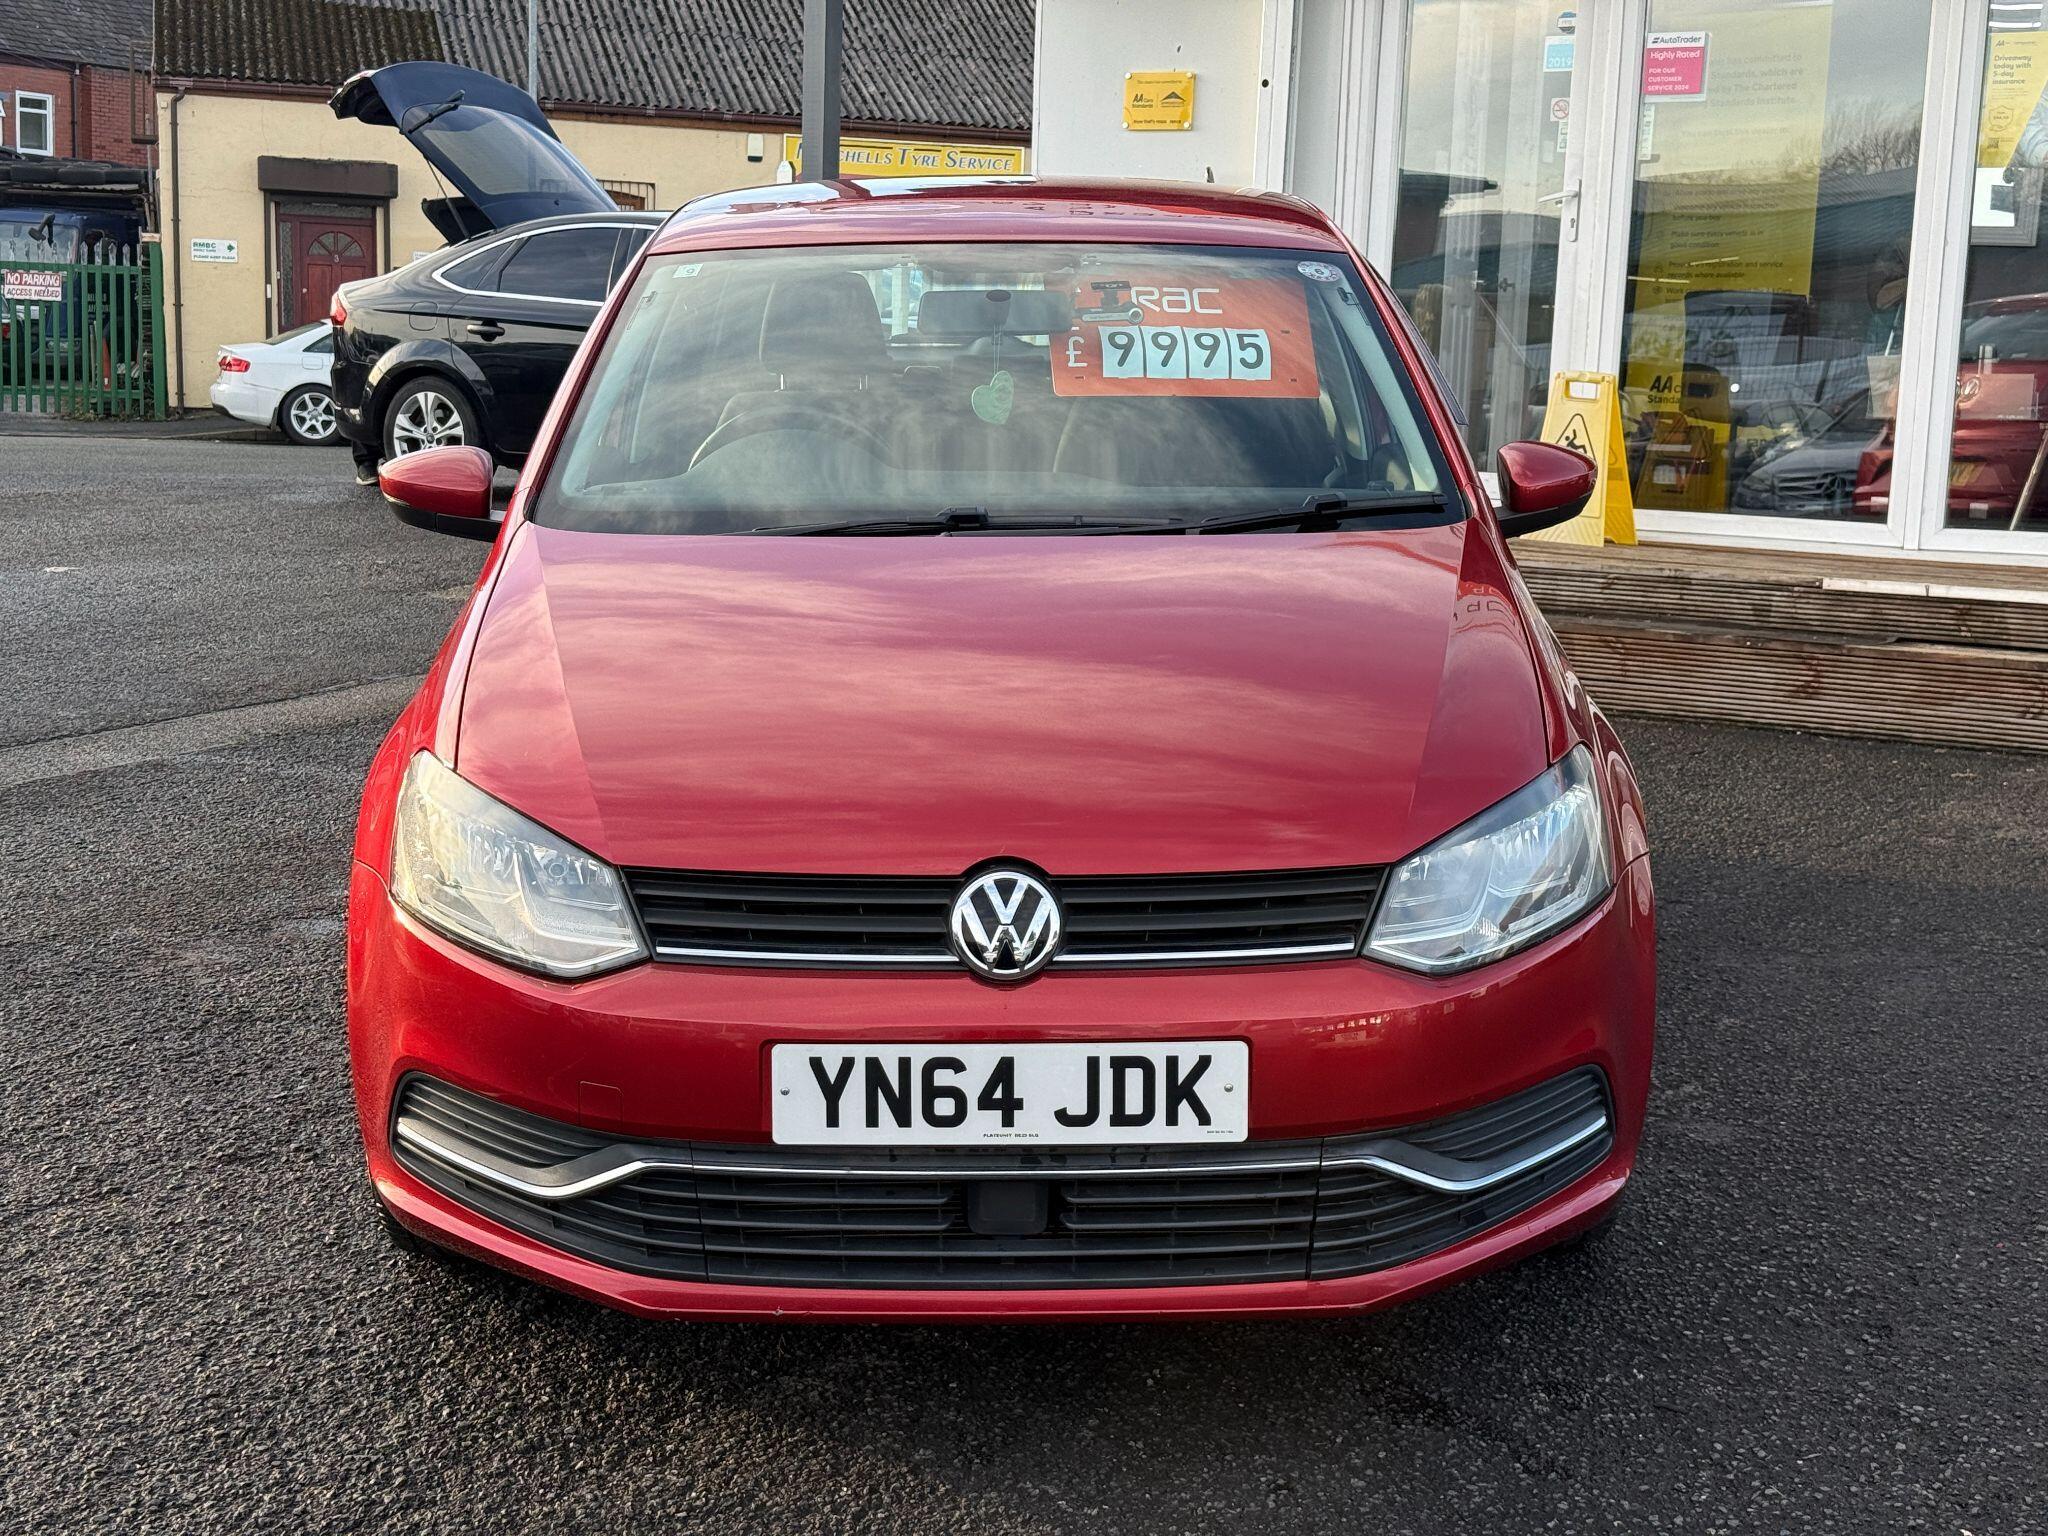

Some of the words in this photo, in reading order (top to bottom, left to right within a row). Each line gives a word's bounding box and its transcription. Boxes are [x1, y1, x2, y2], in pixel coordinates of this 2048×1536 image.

[1660, 36, 1701, 44] AutoTrader
[1650, 50, 1675, 60] Highly
[1676, 49, 1700, 58] Rated
[1994, 54, 2032, 62] Driveaway
[1994, 62, 2014, 71] today
[1993, 71, 2014, 79] 5-day
[1133, 94, 1144, 103] AA
[898, 148, 939, 167] TYRE
[945, 150, 1012, 171] SERVICE
[334, 254, 340, 262] 3
[6, 272, 20, 282] NO
[22, 273, 60, 286] PARKING
[6, 288, 32, 296] ACCESS
[1650, 375, 1673, 394] AA
[808, 1056, 1024, 1128] YN64
[1054, 1054, 1213, 1128] JDK
